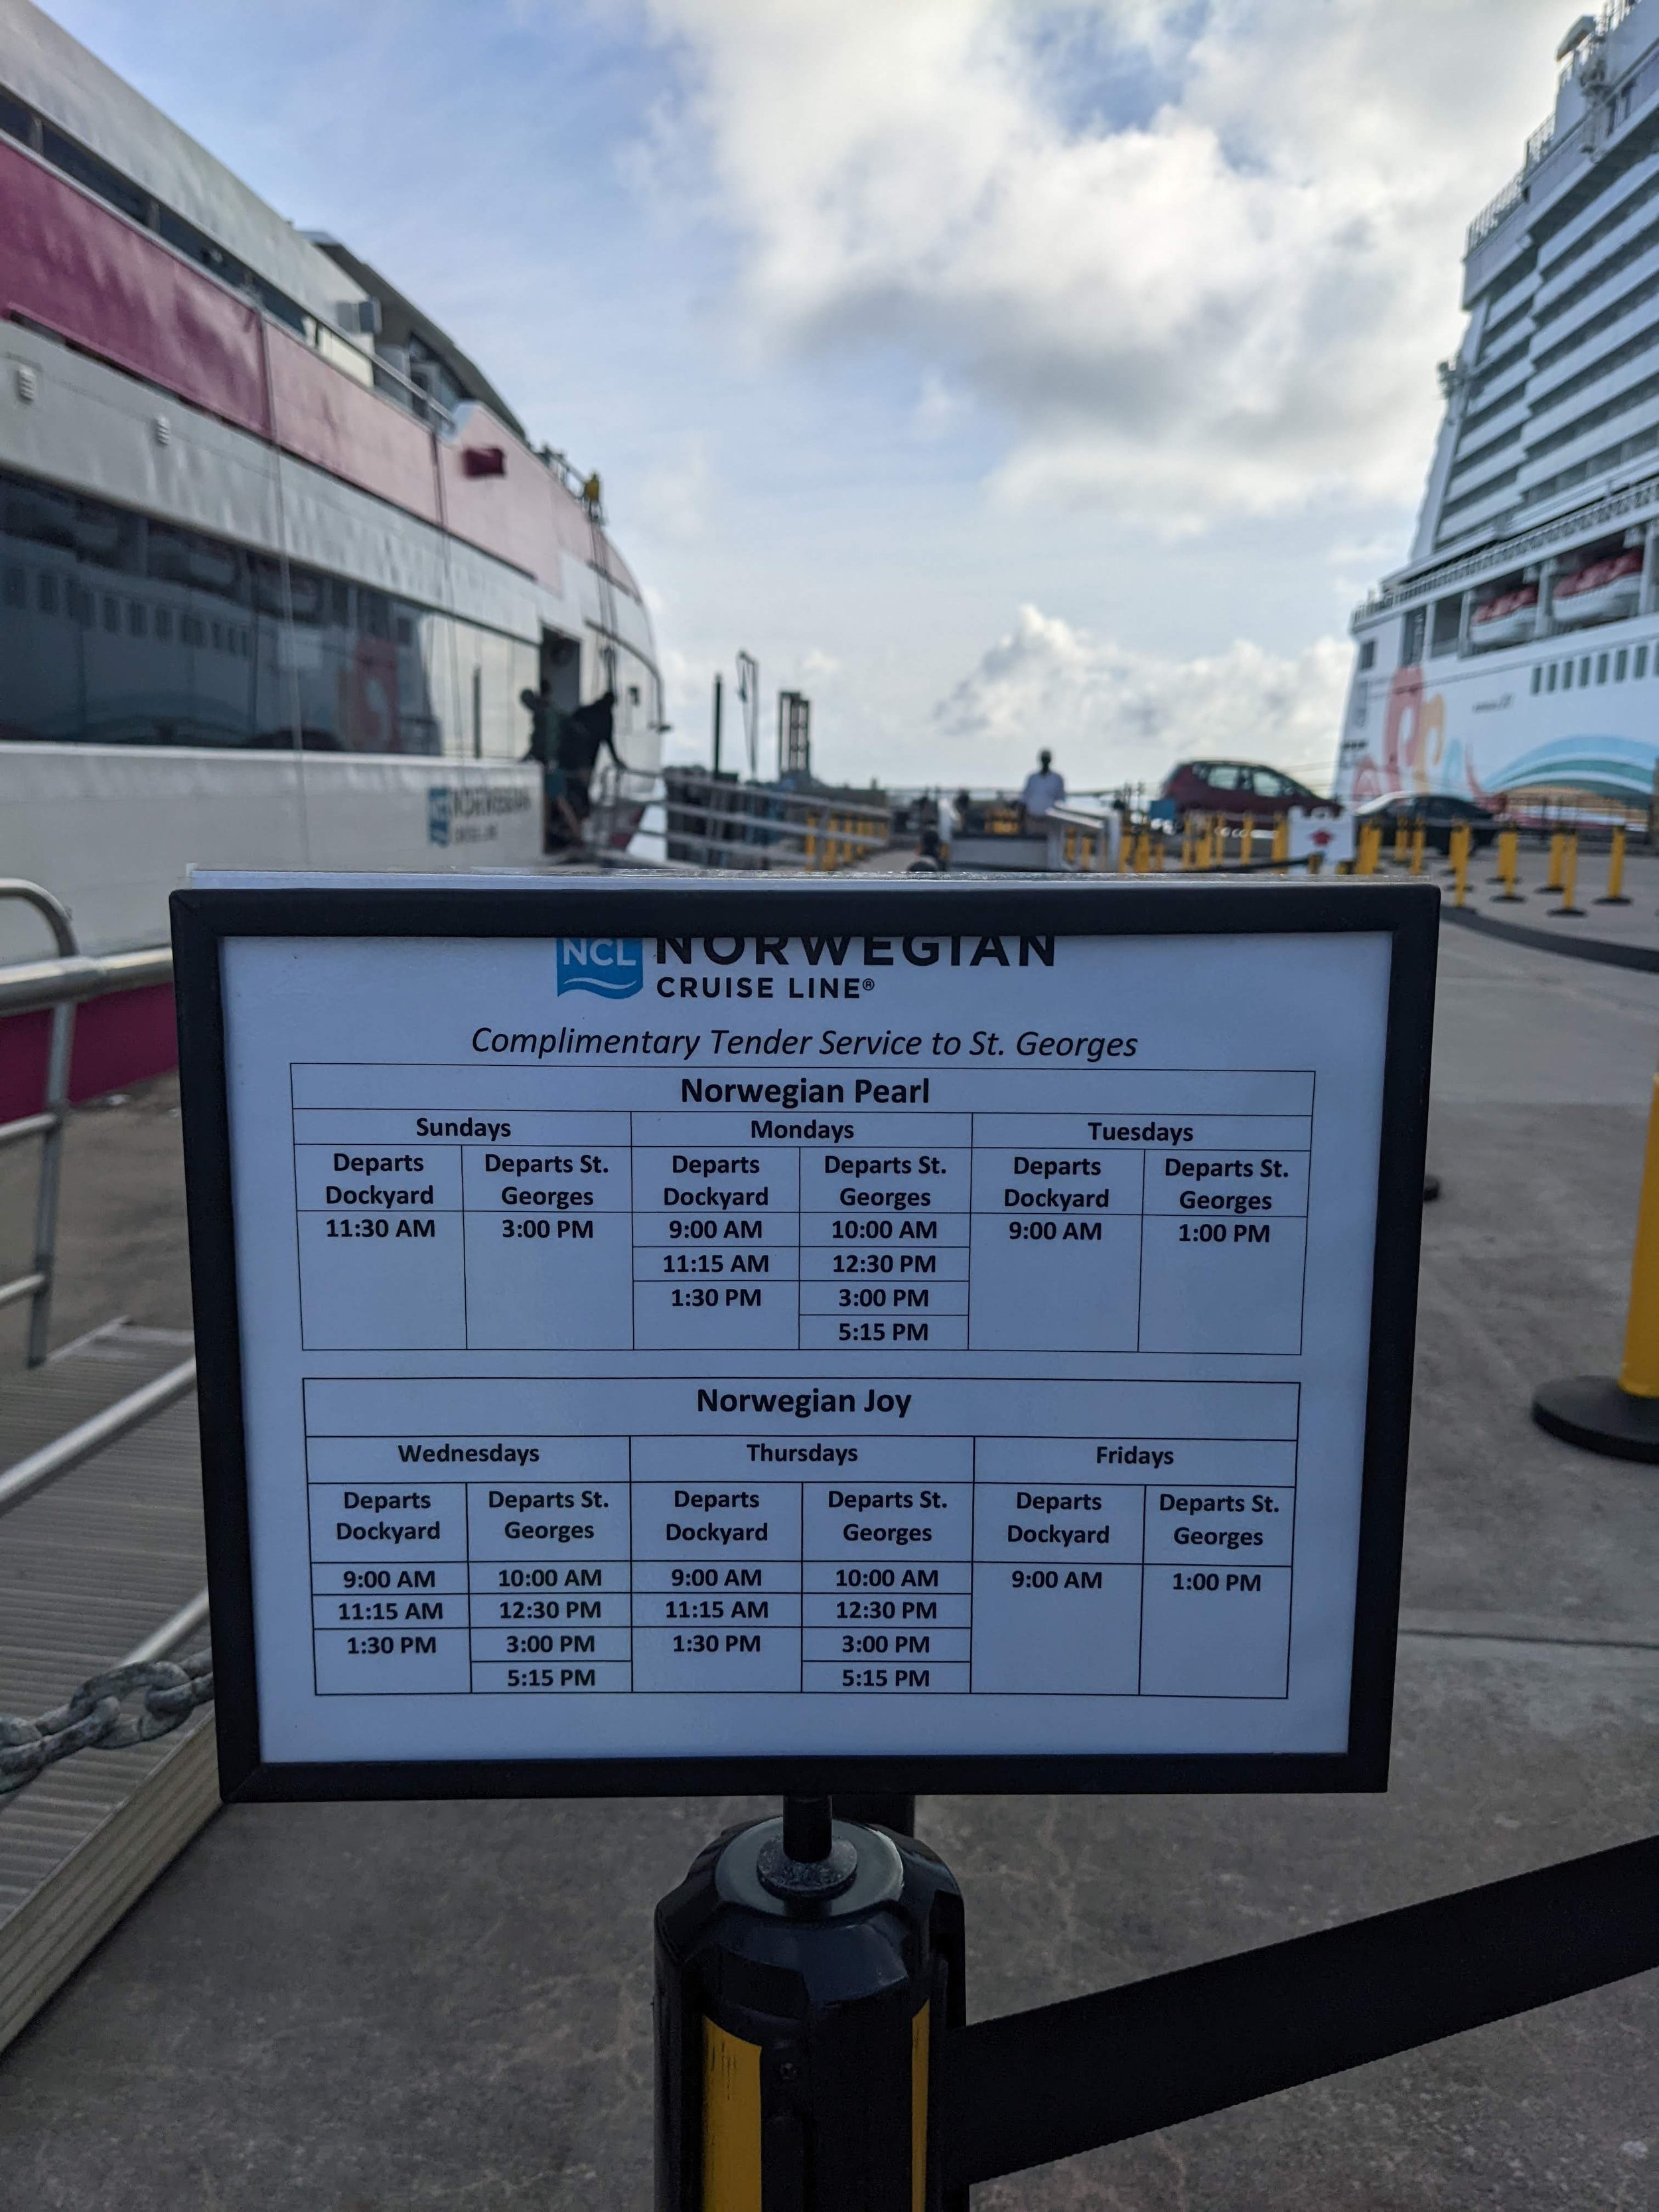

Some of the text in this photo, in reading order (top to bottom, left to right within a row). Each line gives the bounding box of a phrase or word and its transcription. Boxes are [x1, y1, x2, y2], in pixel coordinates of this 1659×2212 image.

[562, 938, 636, 968] NCL
[656, 976, 773, 998] CRUISE
[472, 1027, 1138, 1063] Complimentary Tender Service to St. Georges
[682, 1077, 929, 1109] Norwegian Pearl
[416, 1117, 512, 1142] Sundays
[751, 1119, 854, 1143] Mondays
[1087, 1121, 1194, 1146] Tuesdays
[334, 1153, 424, 1176] Departs
[485, 1153, 609, 1177] Departs St.
[672, 1155, 760, 1178] Departs
[825, 1155, 946, 1179] Departs St.
[1014, 1156, 1102, 1179] Departs
[1165, 1158, 1289, 1181] Departs St.
[326, 1185, 434, 1209] Dockyard
[501, 1186, 594, 1210] Georges
[664, 1186, 768, 1211] Dockyard
[839, 1187, 931, 1211] Georges
[1004, 1187, 1110, 1212] Dockyard
[1179, 1190, 1272, 1214] Georges
[326, 1218, 435, 1238] 11:30 AM
[502, 1219, 593, 1238] 3:00 PM
[669, 1220, 762, 1239] 9:00 AM
[832, 1220, 937, 1239] 10:00 AM
[1009, 1221, 1102, 1240] 9:00 AM
[1179, 1223, 1270, 1243] 1:00 PM
[664, 1254, 769, 1273] 11:15 AM
[833, 1254, 936, 1273] 12:30 PM
[672, 1288, 761, 1307] 1:30 PM
[839, 1288, 929, 1307] 3:00 PM
[839, 1323, 928, 1341] 5:15 PM
[697, 1388, 912, 1418] Norwegian Joy
[397, 1443, 540, 1467] Wednesdays
[746, 1443, 858, 1466] Thursdays
[1096, 1445, 1174, 1469] Fridays
[344, 1491, 431, 1513] Departs
[488, 1490, 609, 1512] Departs St.
[674, 1490, 760, 1512] Departs
[828, 1490, 948, 1512] Departs St.
[1017, 1491, 1102, 1514] Departs
[1160, 1493, 1279, 1516] Departs St.
[336, 1520, 440, 1544] Dockyard
[504, 1521, 595, 1543] Georges
[666, 1522, 768, 1546] Dockyard
[843, 1523, 932, 1546] Georges
[1007, 1524, 1110, 1548] Dockyard
[1173, 1526, 1263, 1550] Georges
[343, 1570, 435, 1588] 9:00 AM
[498, 1569, 602, 1587] 10:00 AM
[672, 1568, 762, 1587] 9:00 AM
[836, 1569, 938, 1587] 10:00 AM
[1011, 1570, 1102, 1589] 9:00 AM
[1173, 1572, 1261, 1591] 1:00 PM
[338, 1602, 443, 1620] 11:15 AM
[500, 1601, 601, 1619] 12:30 PM
[666, 1601, 768, 1619] 11:15 AM
[837, 1601, 937, 1619] 12:30 PM
[347, 1636, 437, 1655] 1:30 PM
[506, 1635, 595, 1653] 3:00 PM
[674, 1635, 760, 1653] 1:30 PM
[842, 1635, 930, 1653] 3:00 PM
[508, 1669, 595, 1687] 5:15 PM
[842, 1669, 930, 1687] 5:15 PM
